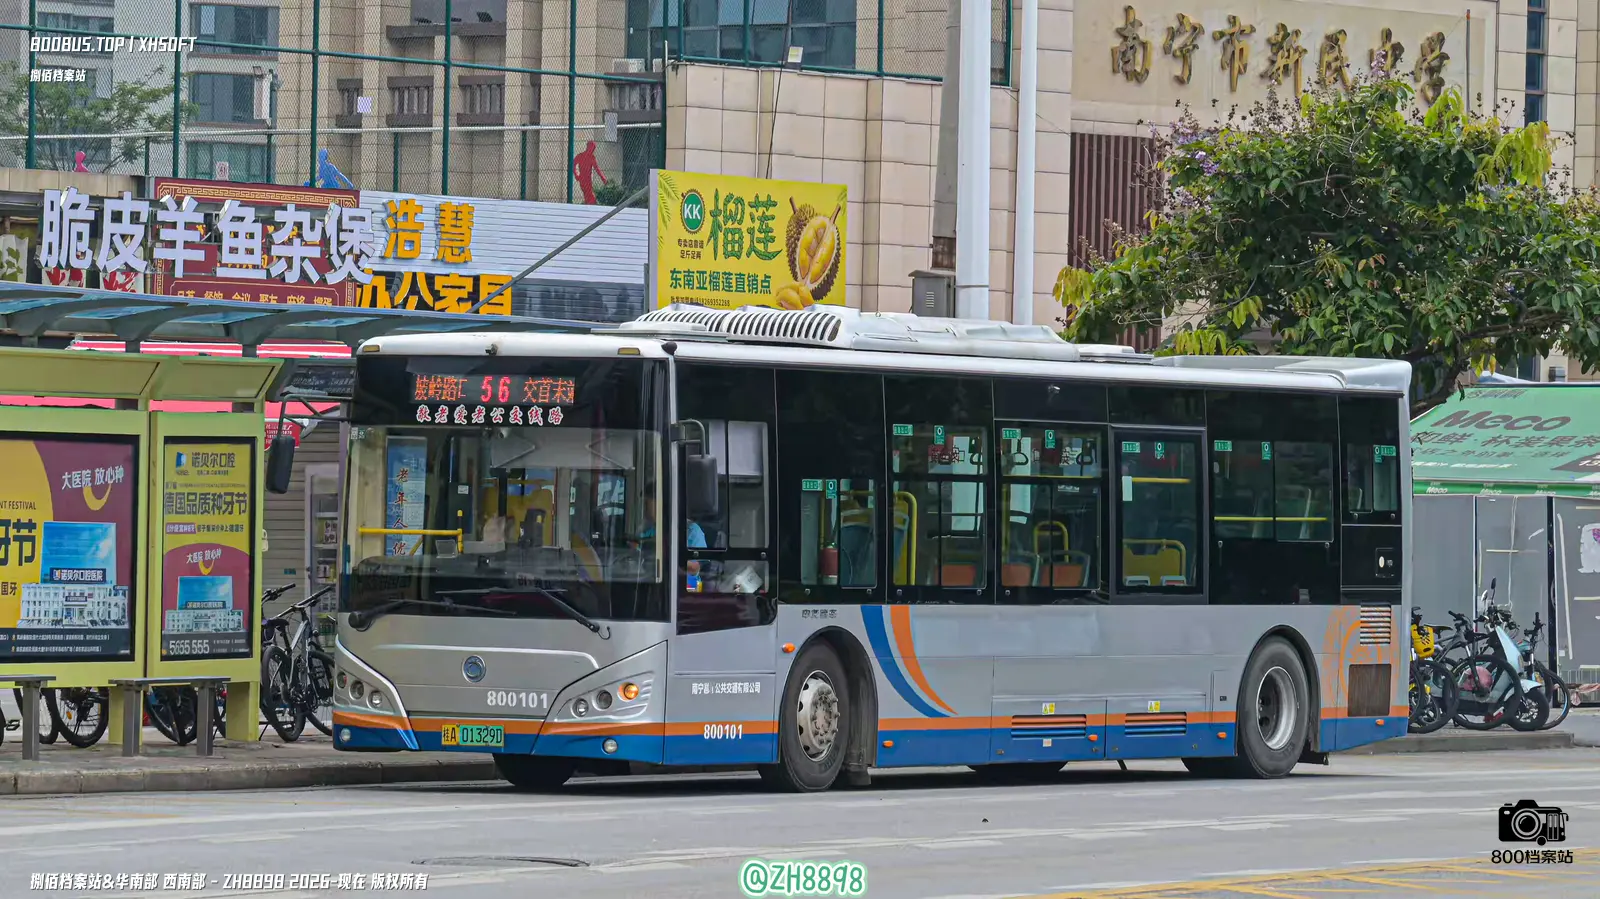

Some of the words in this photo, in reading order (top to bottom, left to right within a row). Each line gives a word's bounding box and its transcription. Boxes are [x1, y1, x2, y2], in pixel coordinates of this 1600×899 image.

[684, 204, 702, 220] KK
[39, 186, 375, 285] 脆皮羊鱼杂煲
[384, 198, 475, 264] 浩慧
[705, 188, 783, 261] 榴莲
[669, 267, 772, 295] 东南亚榴莲直销点
[480, 375, 511, 403] 56
[416, 403, 564, 426] 敬老爱老公交线路
[1430, 410, 1571, 431] Meco
[191, 452, 236, 468] 诺贝尔口腔
[61, 470, 92, 490] 大医院
[94, 465, 125, 486] 放心种
[8, 500, 37, 510] FESTIVAL
[164, 491, 248, 516] 德国品质种牙节
[486, 690, 548, 709] 800101
[461, 727, 503, 744] 01329D
[703, 723, 744, 740] 800101
